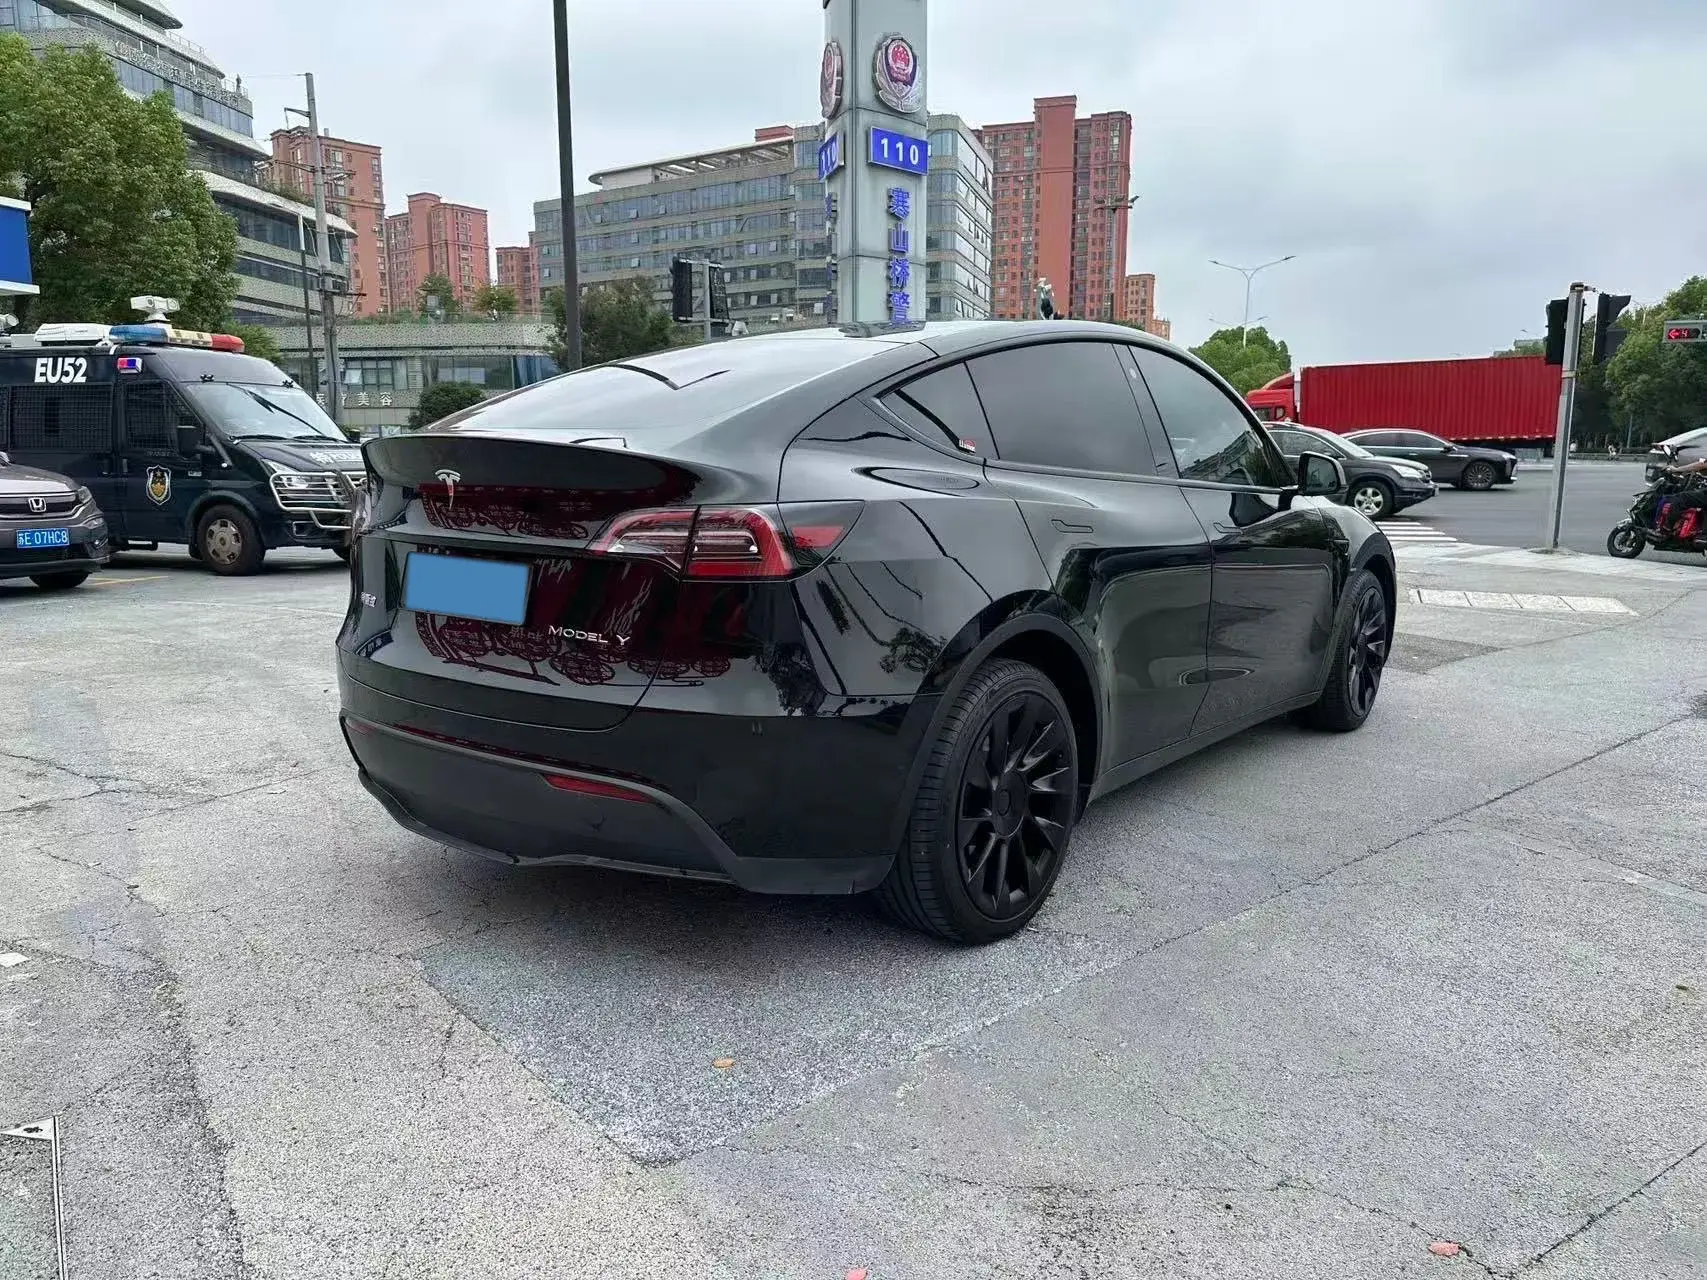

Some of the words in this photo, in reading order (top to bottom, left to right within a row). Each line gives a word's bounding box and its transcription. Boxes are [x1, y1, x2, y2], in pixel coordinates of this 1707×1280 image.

[881, 137, 919, 165] 110
[34, 357, 88, 383] EU52
[548, 625, 608, 643] MODEL
[616, 634, 631, 646] Y
